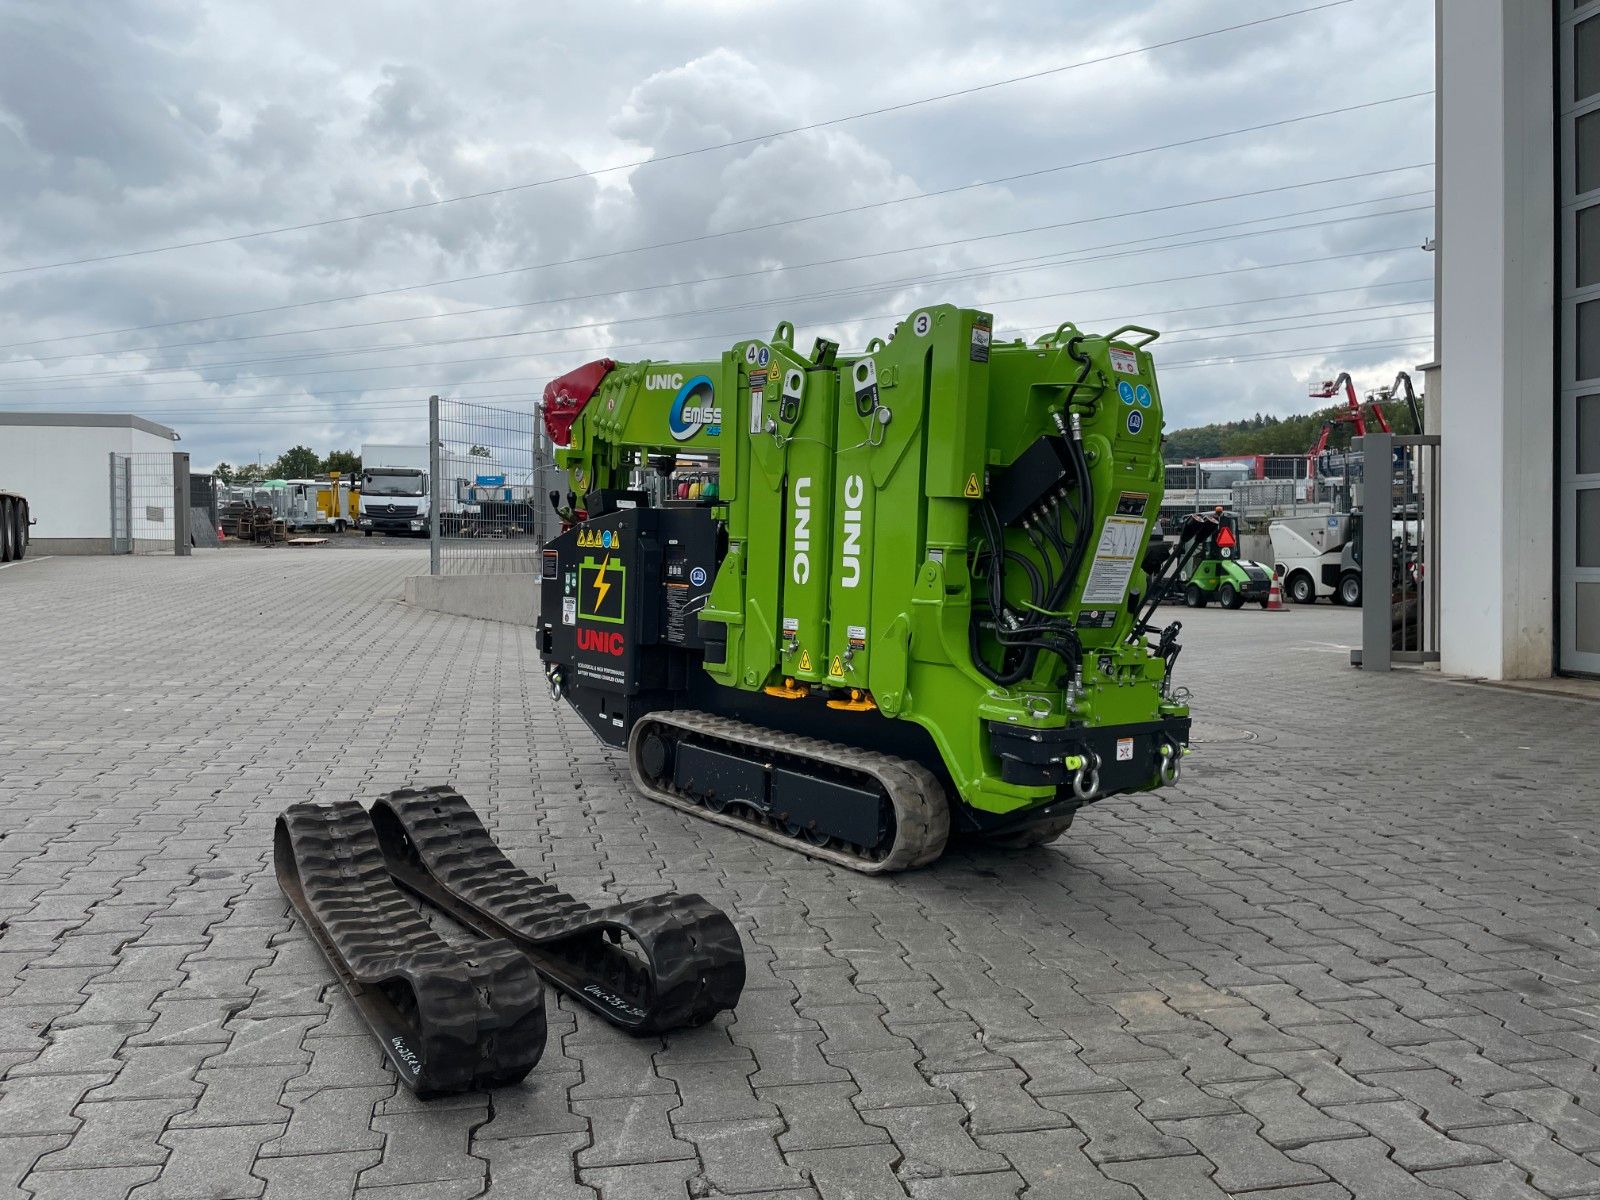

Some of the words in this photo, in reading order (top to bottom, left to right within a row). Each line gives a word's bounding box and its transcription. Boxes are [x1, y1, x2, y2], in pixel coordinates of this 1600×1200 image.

[917, 316, 928, 333] 3
[748, 346, 756, 360] 4
[646, 373, 683, 391] UNIC
[793, 477, 811, 585] UNIC
[841, 475, 864, 588] UNIC
[577, 627, 624, 656] UNIC
